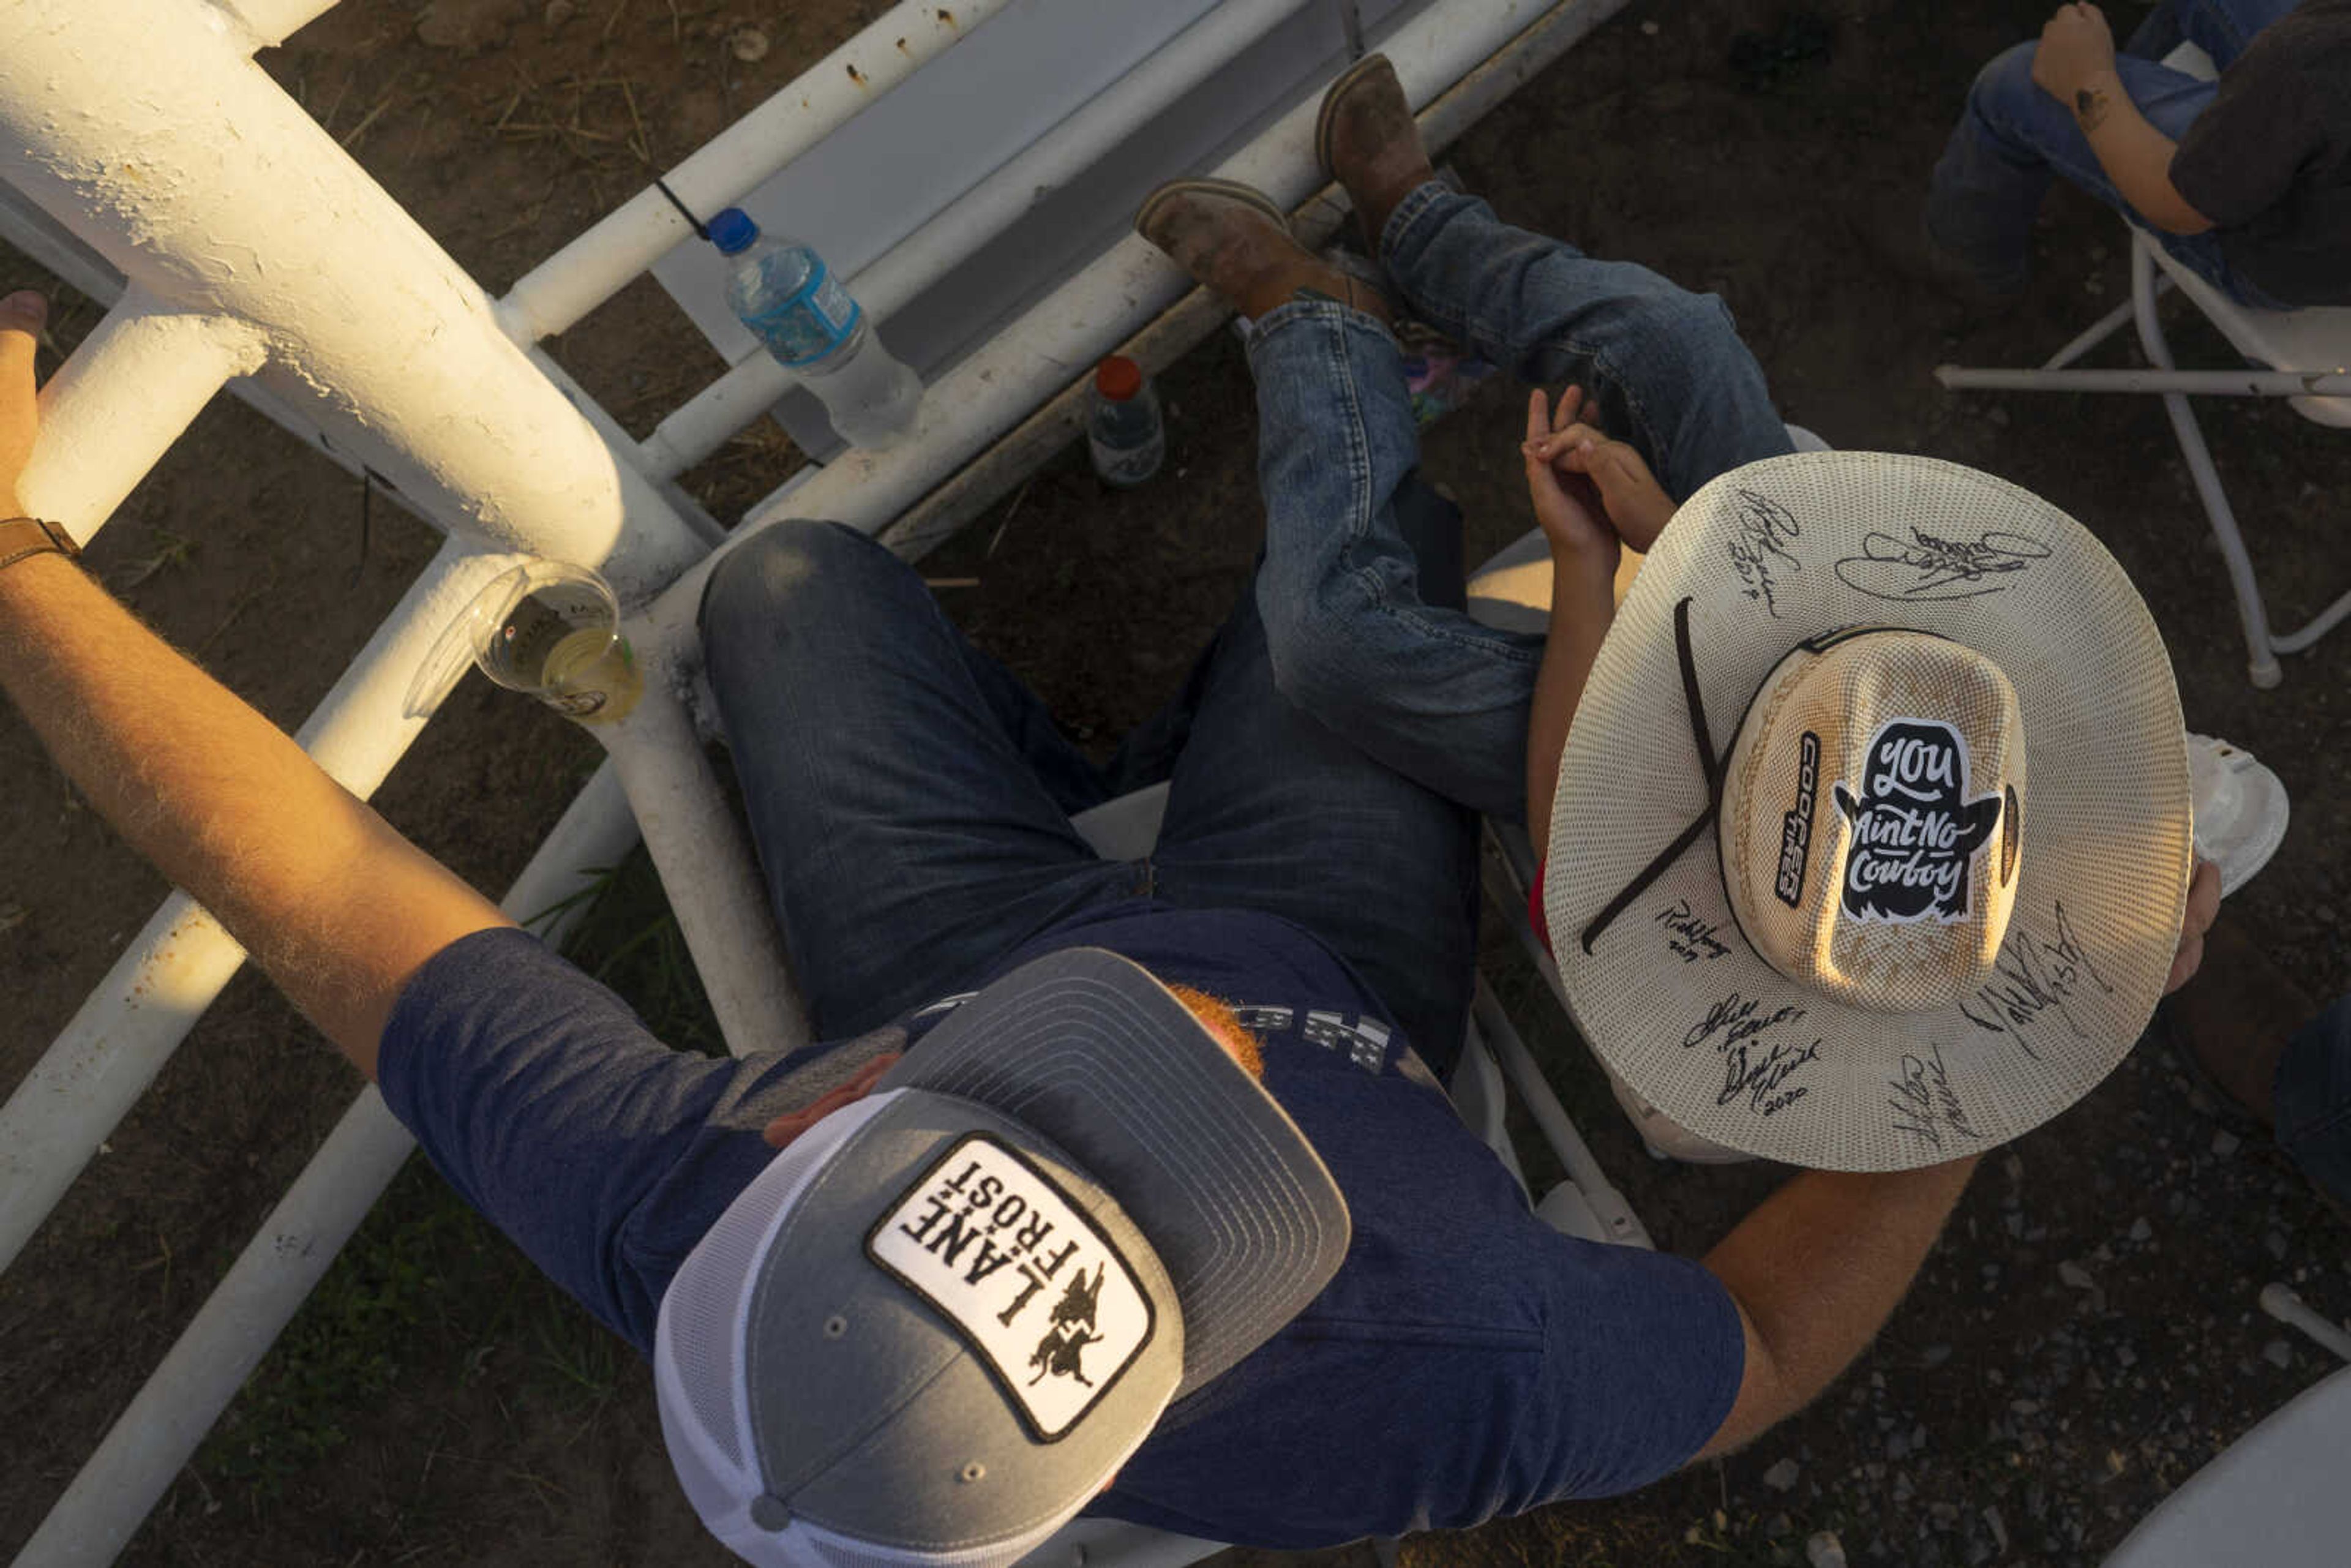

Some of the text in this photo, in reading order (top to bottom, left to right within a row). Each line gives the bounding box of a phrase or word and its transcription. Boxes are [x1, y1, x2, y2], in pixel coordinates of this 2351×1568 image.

[1779, 814, 1798, 896] TIRES
[1788, 736, 1817, 900] COOPER
[1919, 811, 1974, 847] No
[1850, 850, 1962, 901] Cowboy
[900, 1195, 1044, 1327] LANE
[945, 1161, 1079, 1281] FROST
